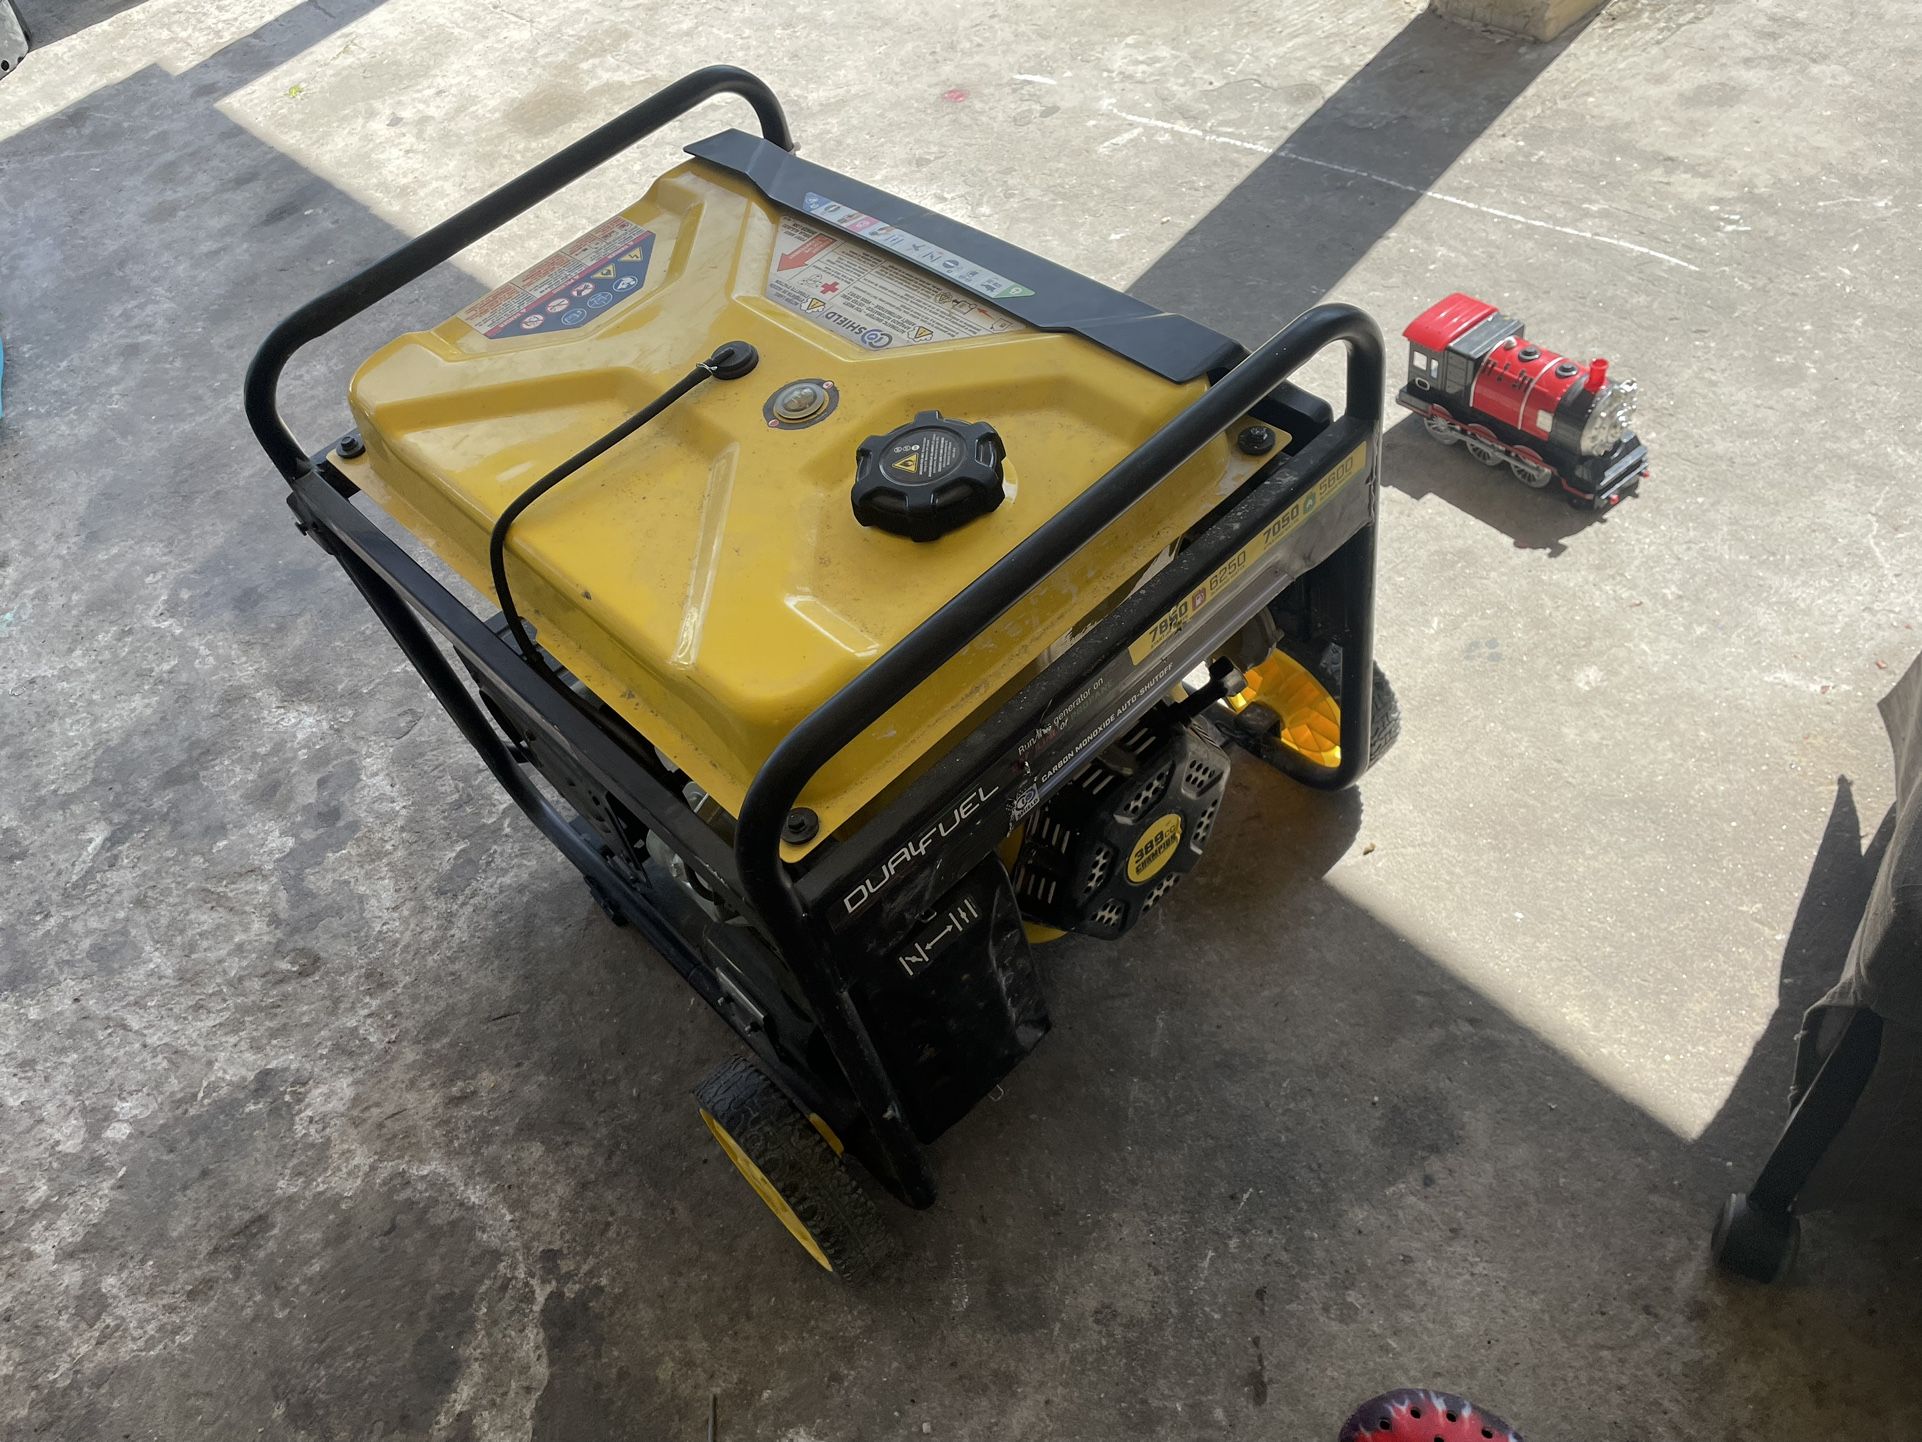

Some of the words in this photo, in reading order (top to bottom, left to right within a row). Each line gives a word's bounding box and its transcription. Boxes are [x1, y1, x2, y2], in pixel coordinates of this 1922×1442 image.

[825, 311, 867, 335] SHIELD
[1264, 504, 1299, 545] 7050
[1320, 456, 1353, 496] 5600
[1210, 550, 1246, 591] 6250
[1018, 737, 1036, 756] Run
[1053, 687, 1092, 728] generator
[1093, 677, 1104, 691] on
[1041, 751, 1074, 783] CARBON
[1075, 714, 1116, 753] MONOXIDE
[1116, 662, 1174, 717] AUTO-SHUTOFF
[1060, 718, 1068, 730] or
[1136, 832, 1177, 876] CHAMPION
